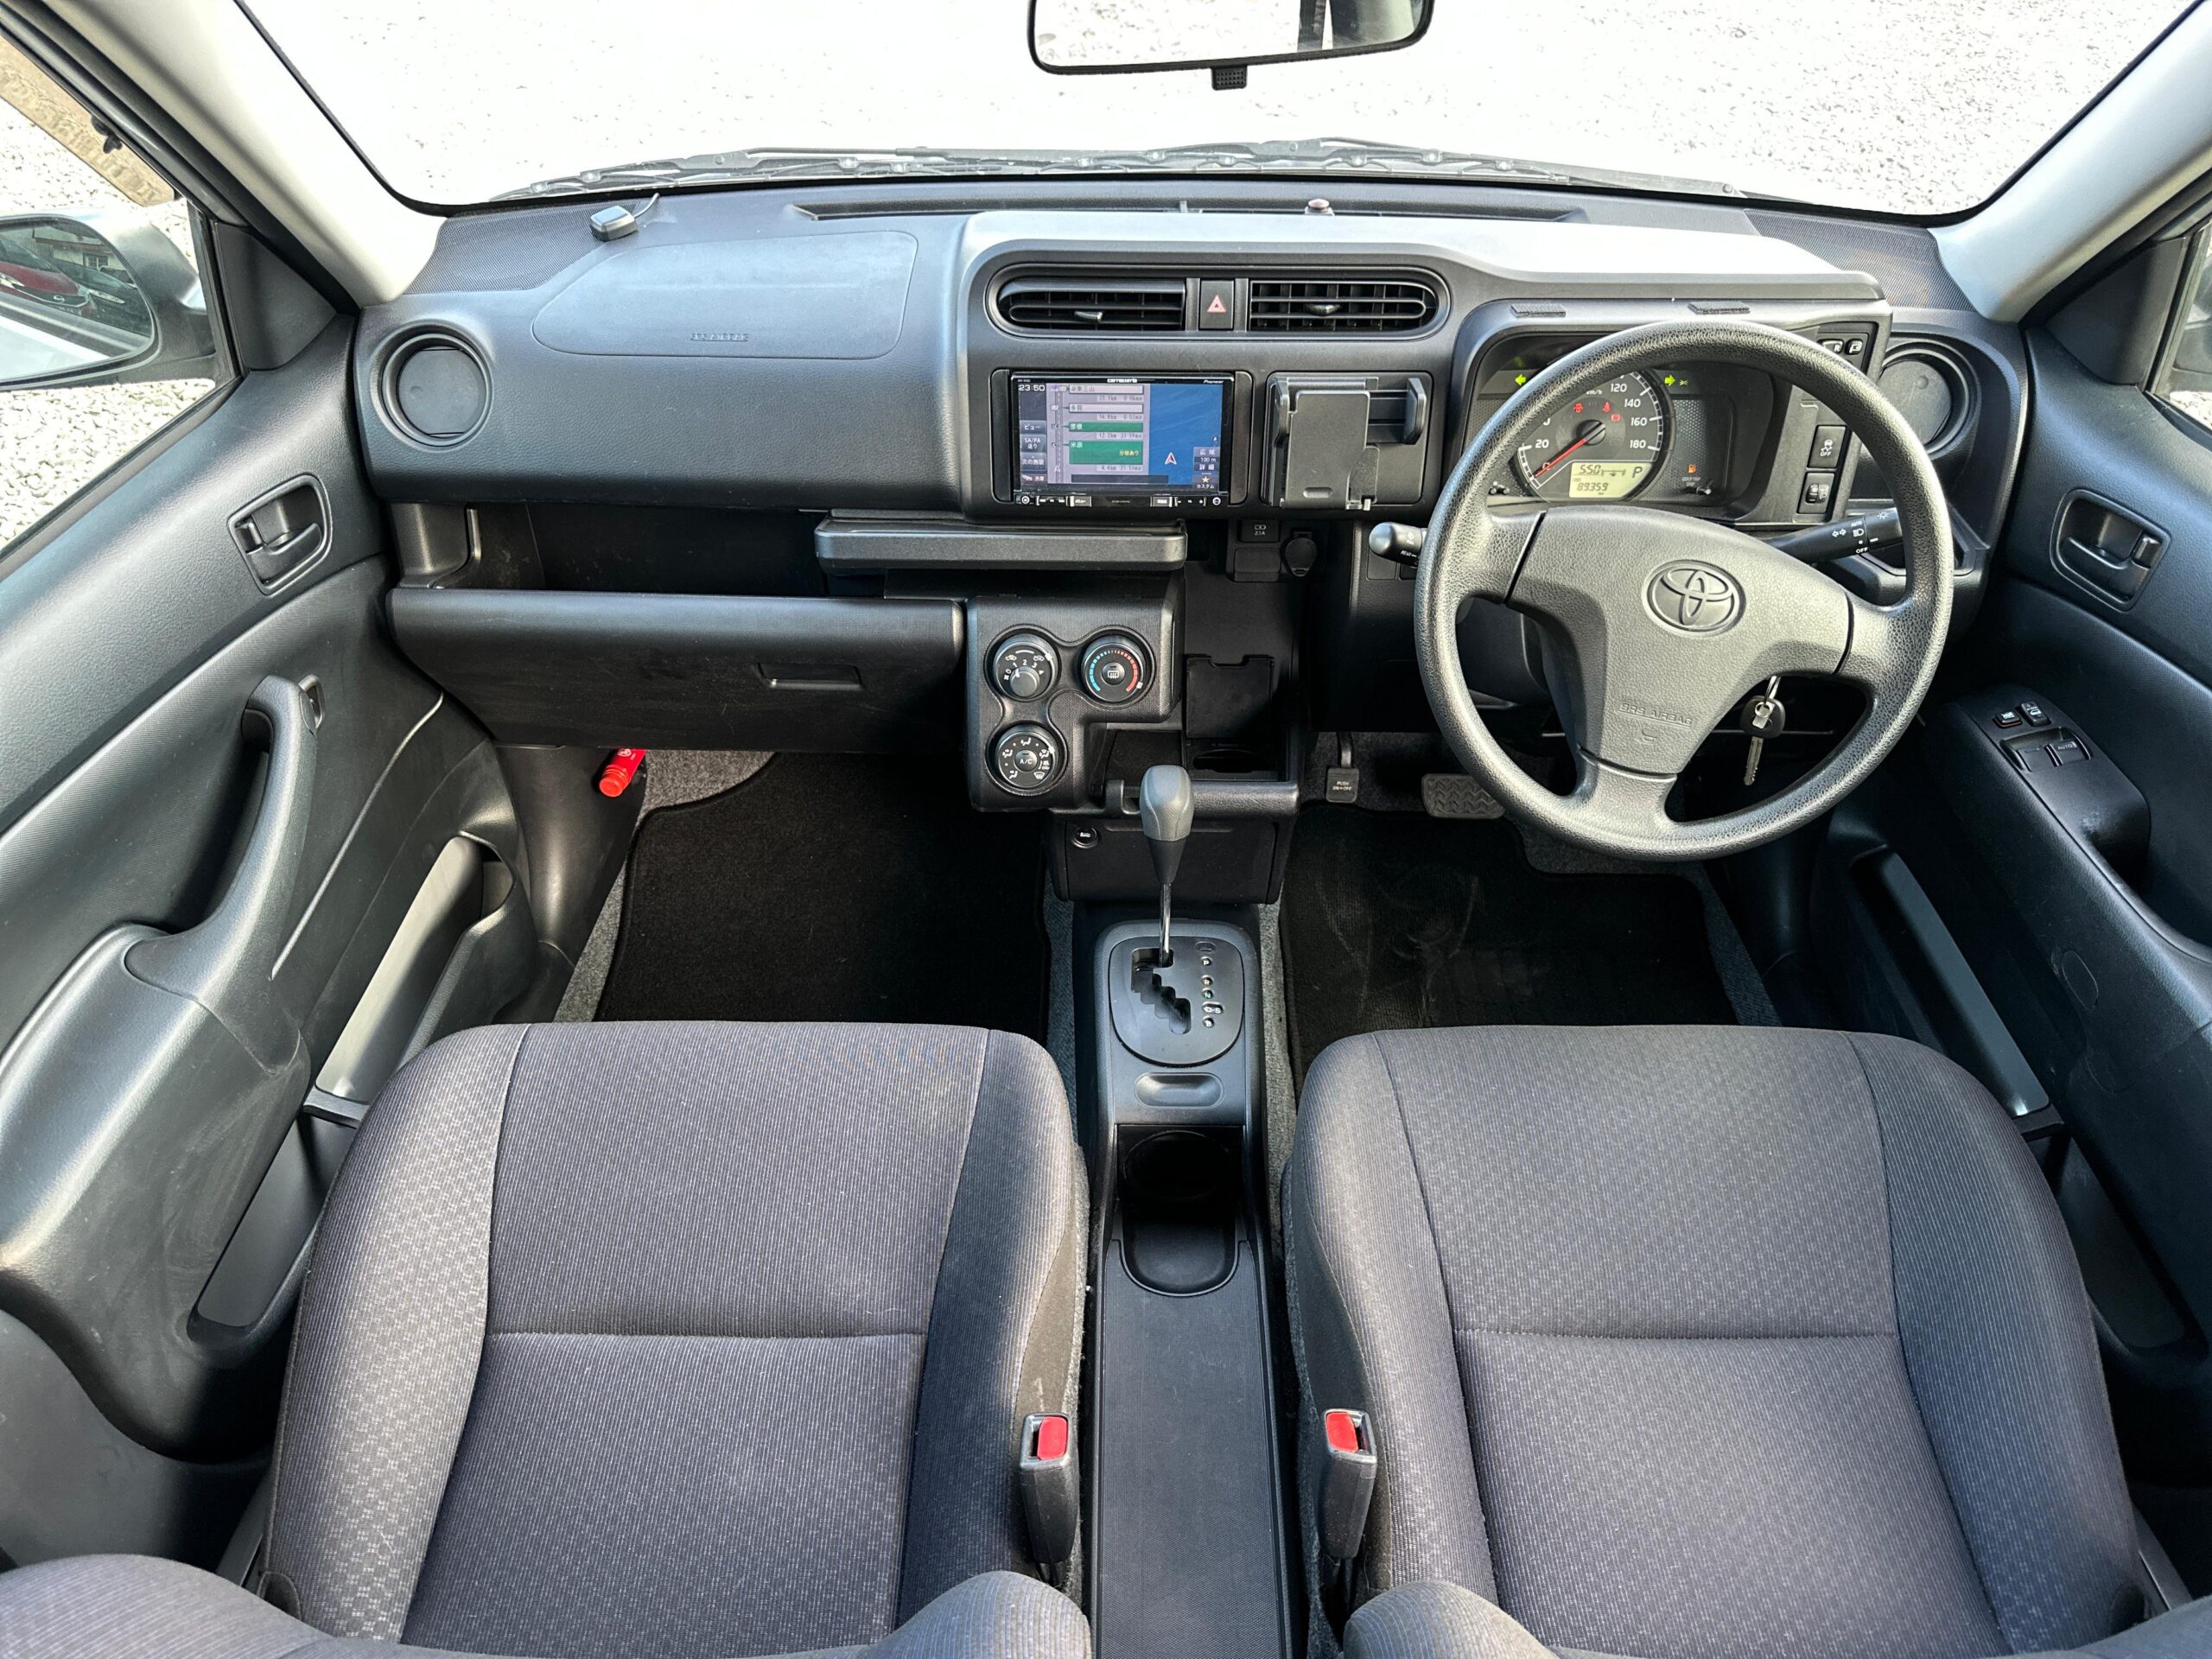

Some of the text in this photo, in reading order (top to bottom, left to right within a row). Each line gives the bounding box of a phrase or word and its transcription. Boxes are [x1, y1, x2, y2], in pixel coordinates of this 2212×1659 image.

[1610, 383, 1627, 393] 120
[1624, 398, 1641, 408] 140
[1630, 417, 1648, 426] 160
[1535, 439, 1549, 448] 20
[1630, 439, 1646, 449] 180
[1632, 467, 1643, 478] P
[1577, 482, 1609, 492] 89359
[1650, 709, 1692, 725] AIRBAG
